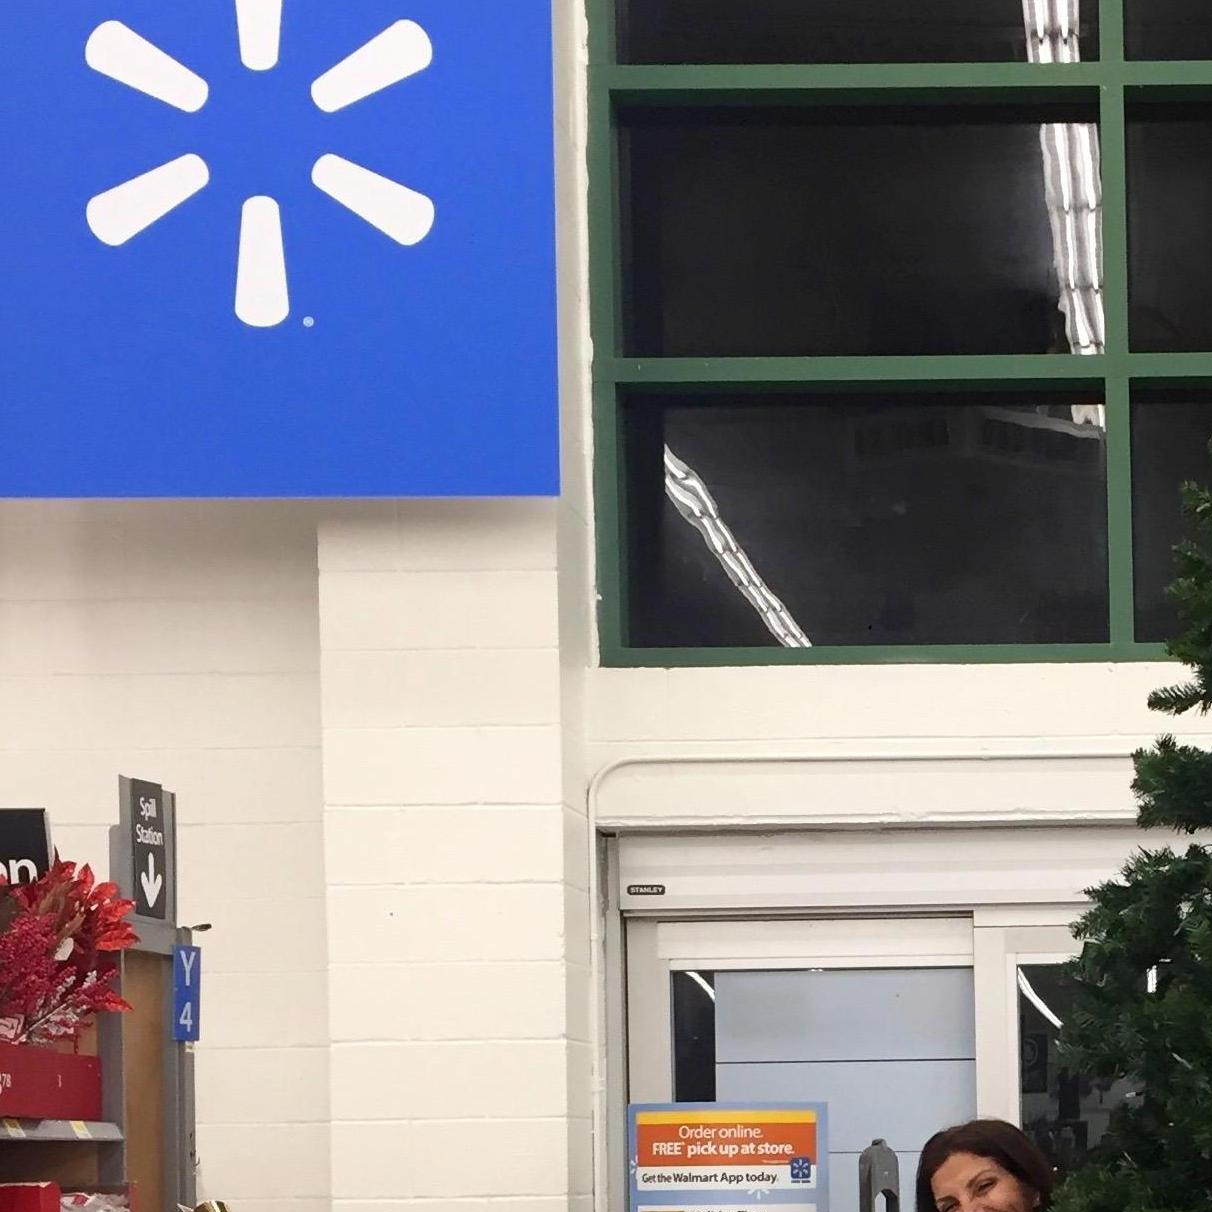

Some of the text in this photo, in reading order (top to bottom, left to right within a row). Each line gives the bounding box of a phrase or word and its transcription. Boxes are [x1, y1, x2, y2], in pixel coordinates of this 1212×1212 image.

[140, 797, 157, 821] Spill
[136, 824, 163, 846] Station
[629, 886, 663, 894] STANLEY
[180, 950, 196, 986] Y
[179, 1002, 193, 1032] 4
[678, 1125, 764, 1139] Order online.
[687, 1141, 717, 1158] pick
[719, 1144, 738, 1158] up
[742, 1143, 756, 1155] at
[757, 1142, 795, 1155] store.
[641, 1172, 656, 1183] Get
[657, 1172, 672, 1183] the
[672, 1171, 718, 1183] Walmart
[720, 1172, 744, 1184] App
